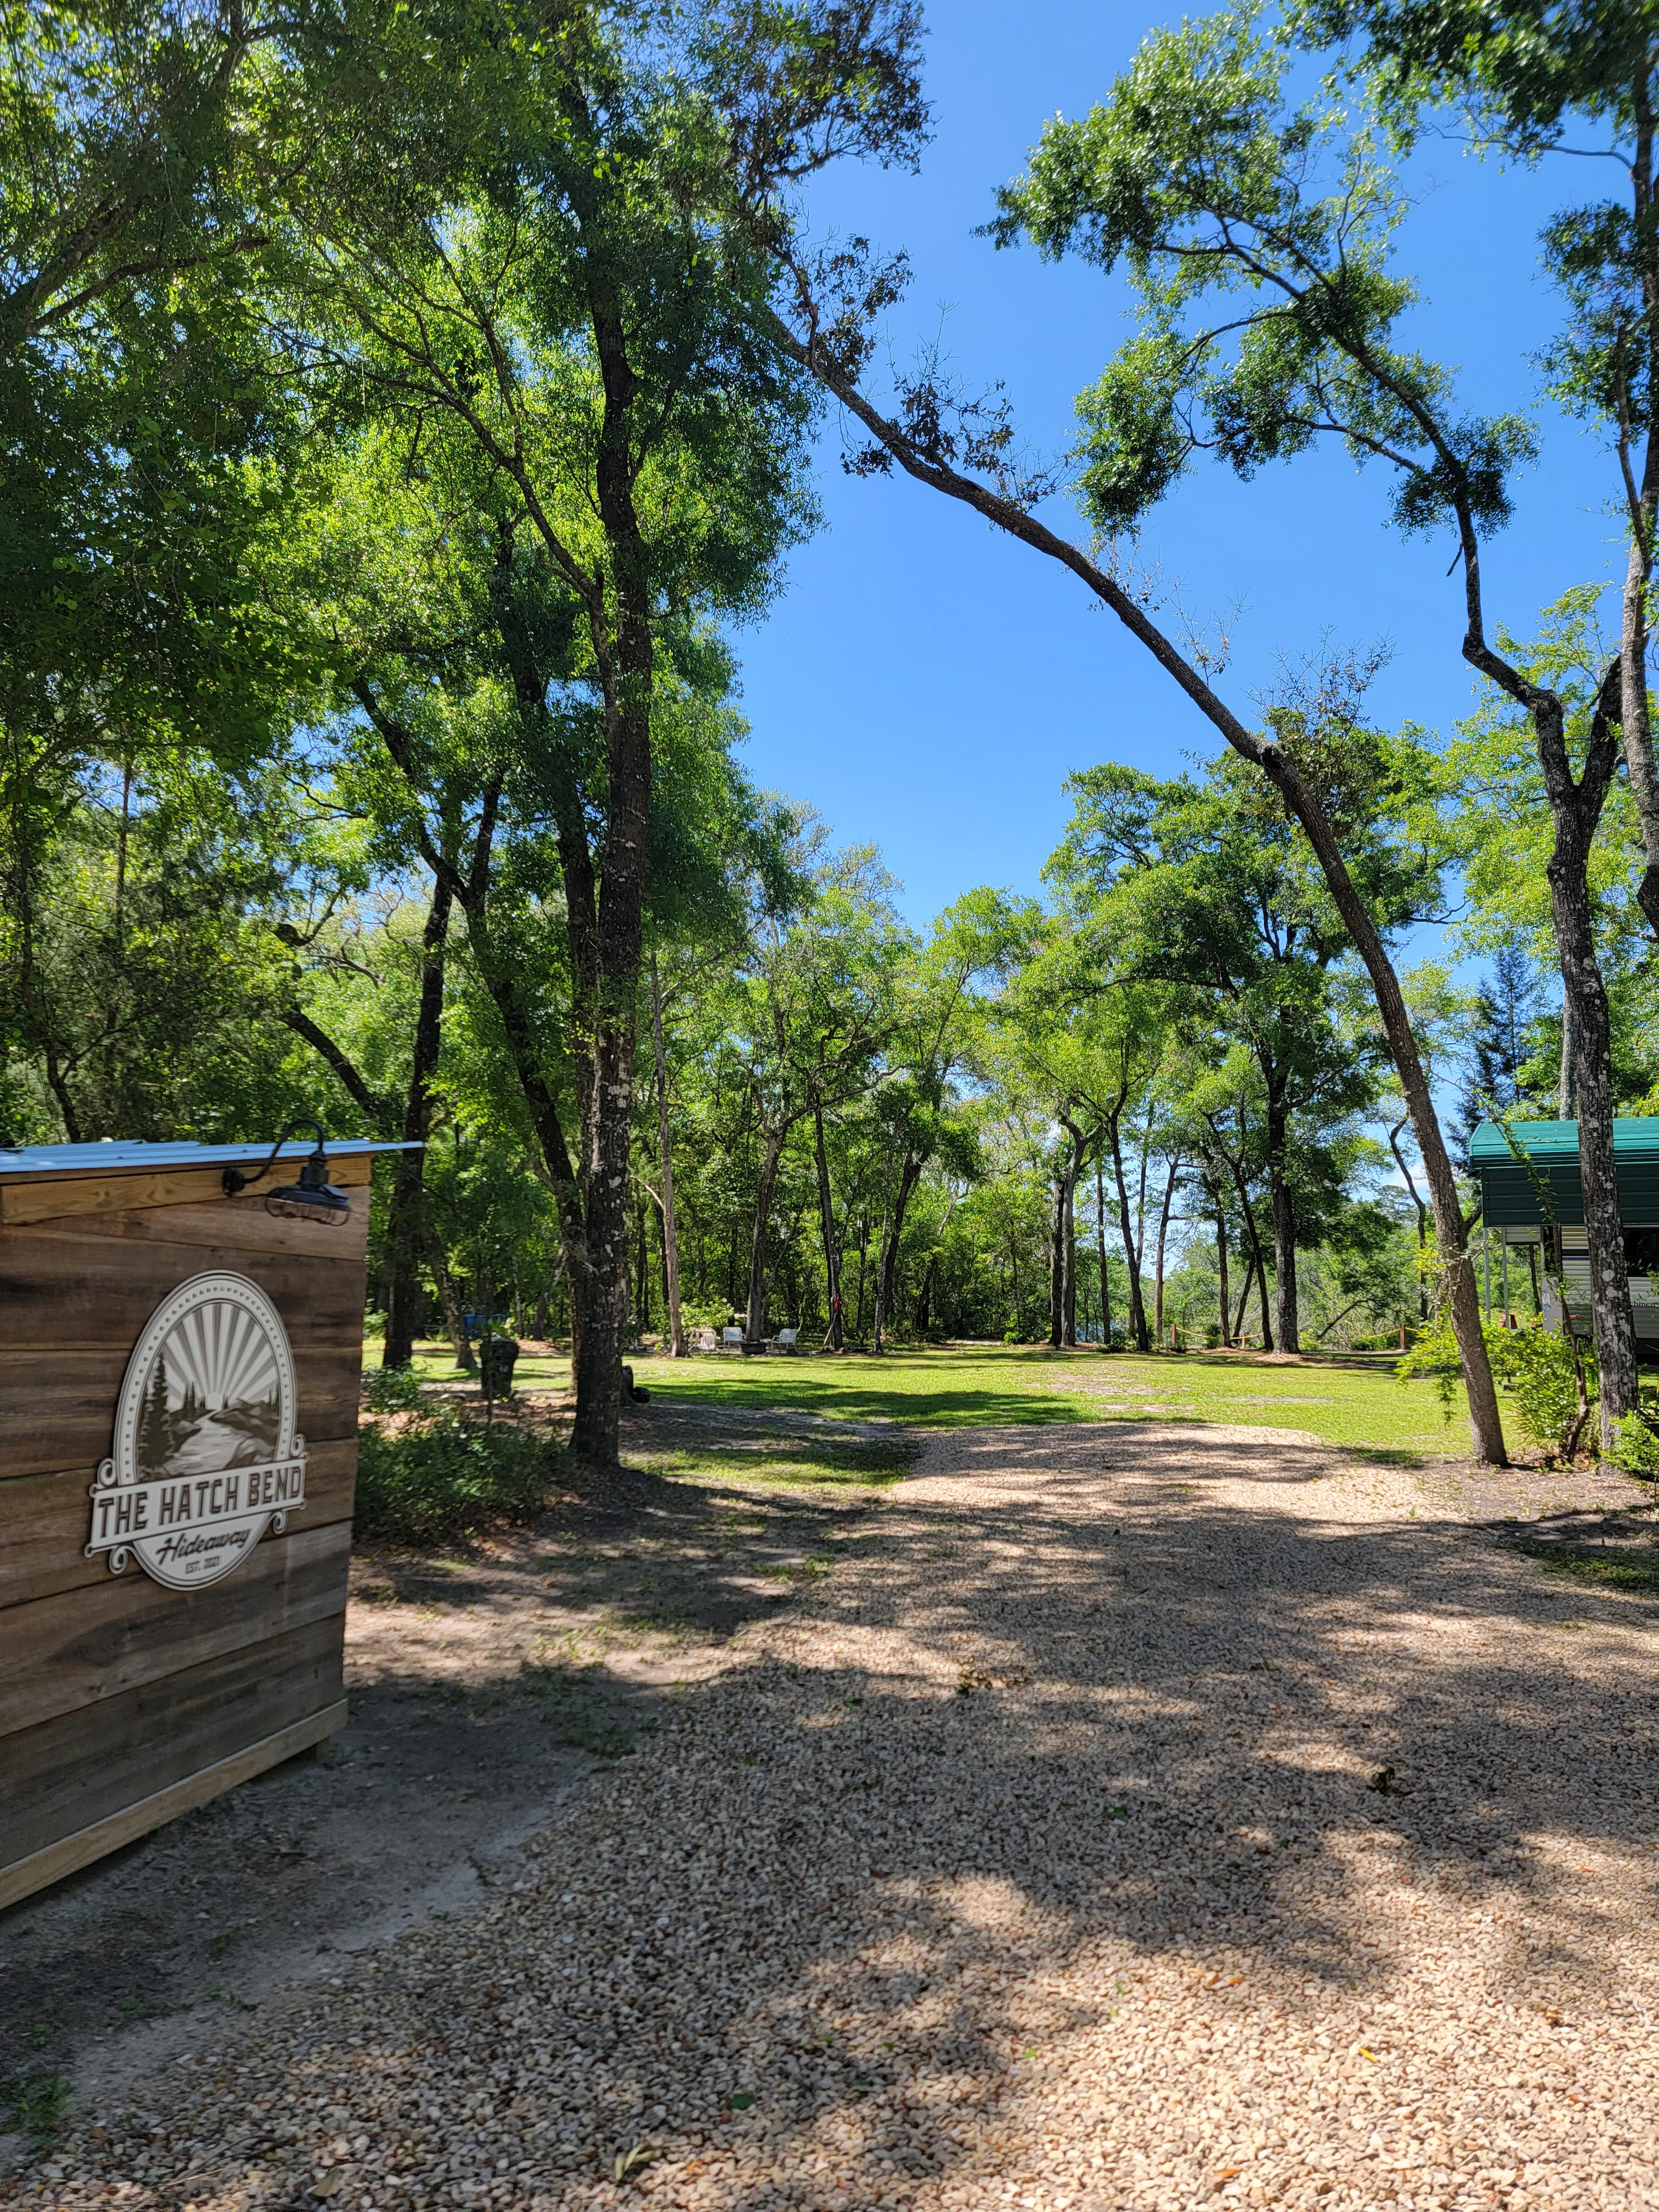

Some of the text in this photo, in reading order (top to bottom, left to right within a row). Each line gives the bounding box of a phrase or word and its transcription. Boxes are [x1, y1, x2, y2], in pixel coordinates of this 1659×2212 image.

[98, 1467, 301, 1538] THE HATCH BEND
[155, 1529, 252, 1566] Hideaway
